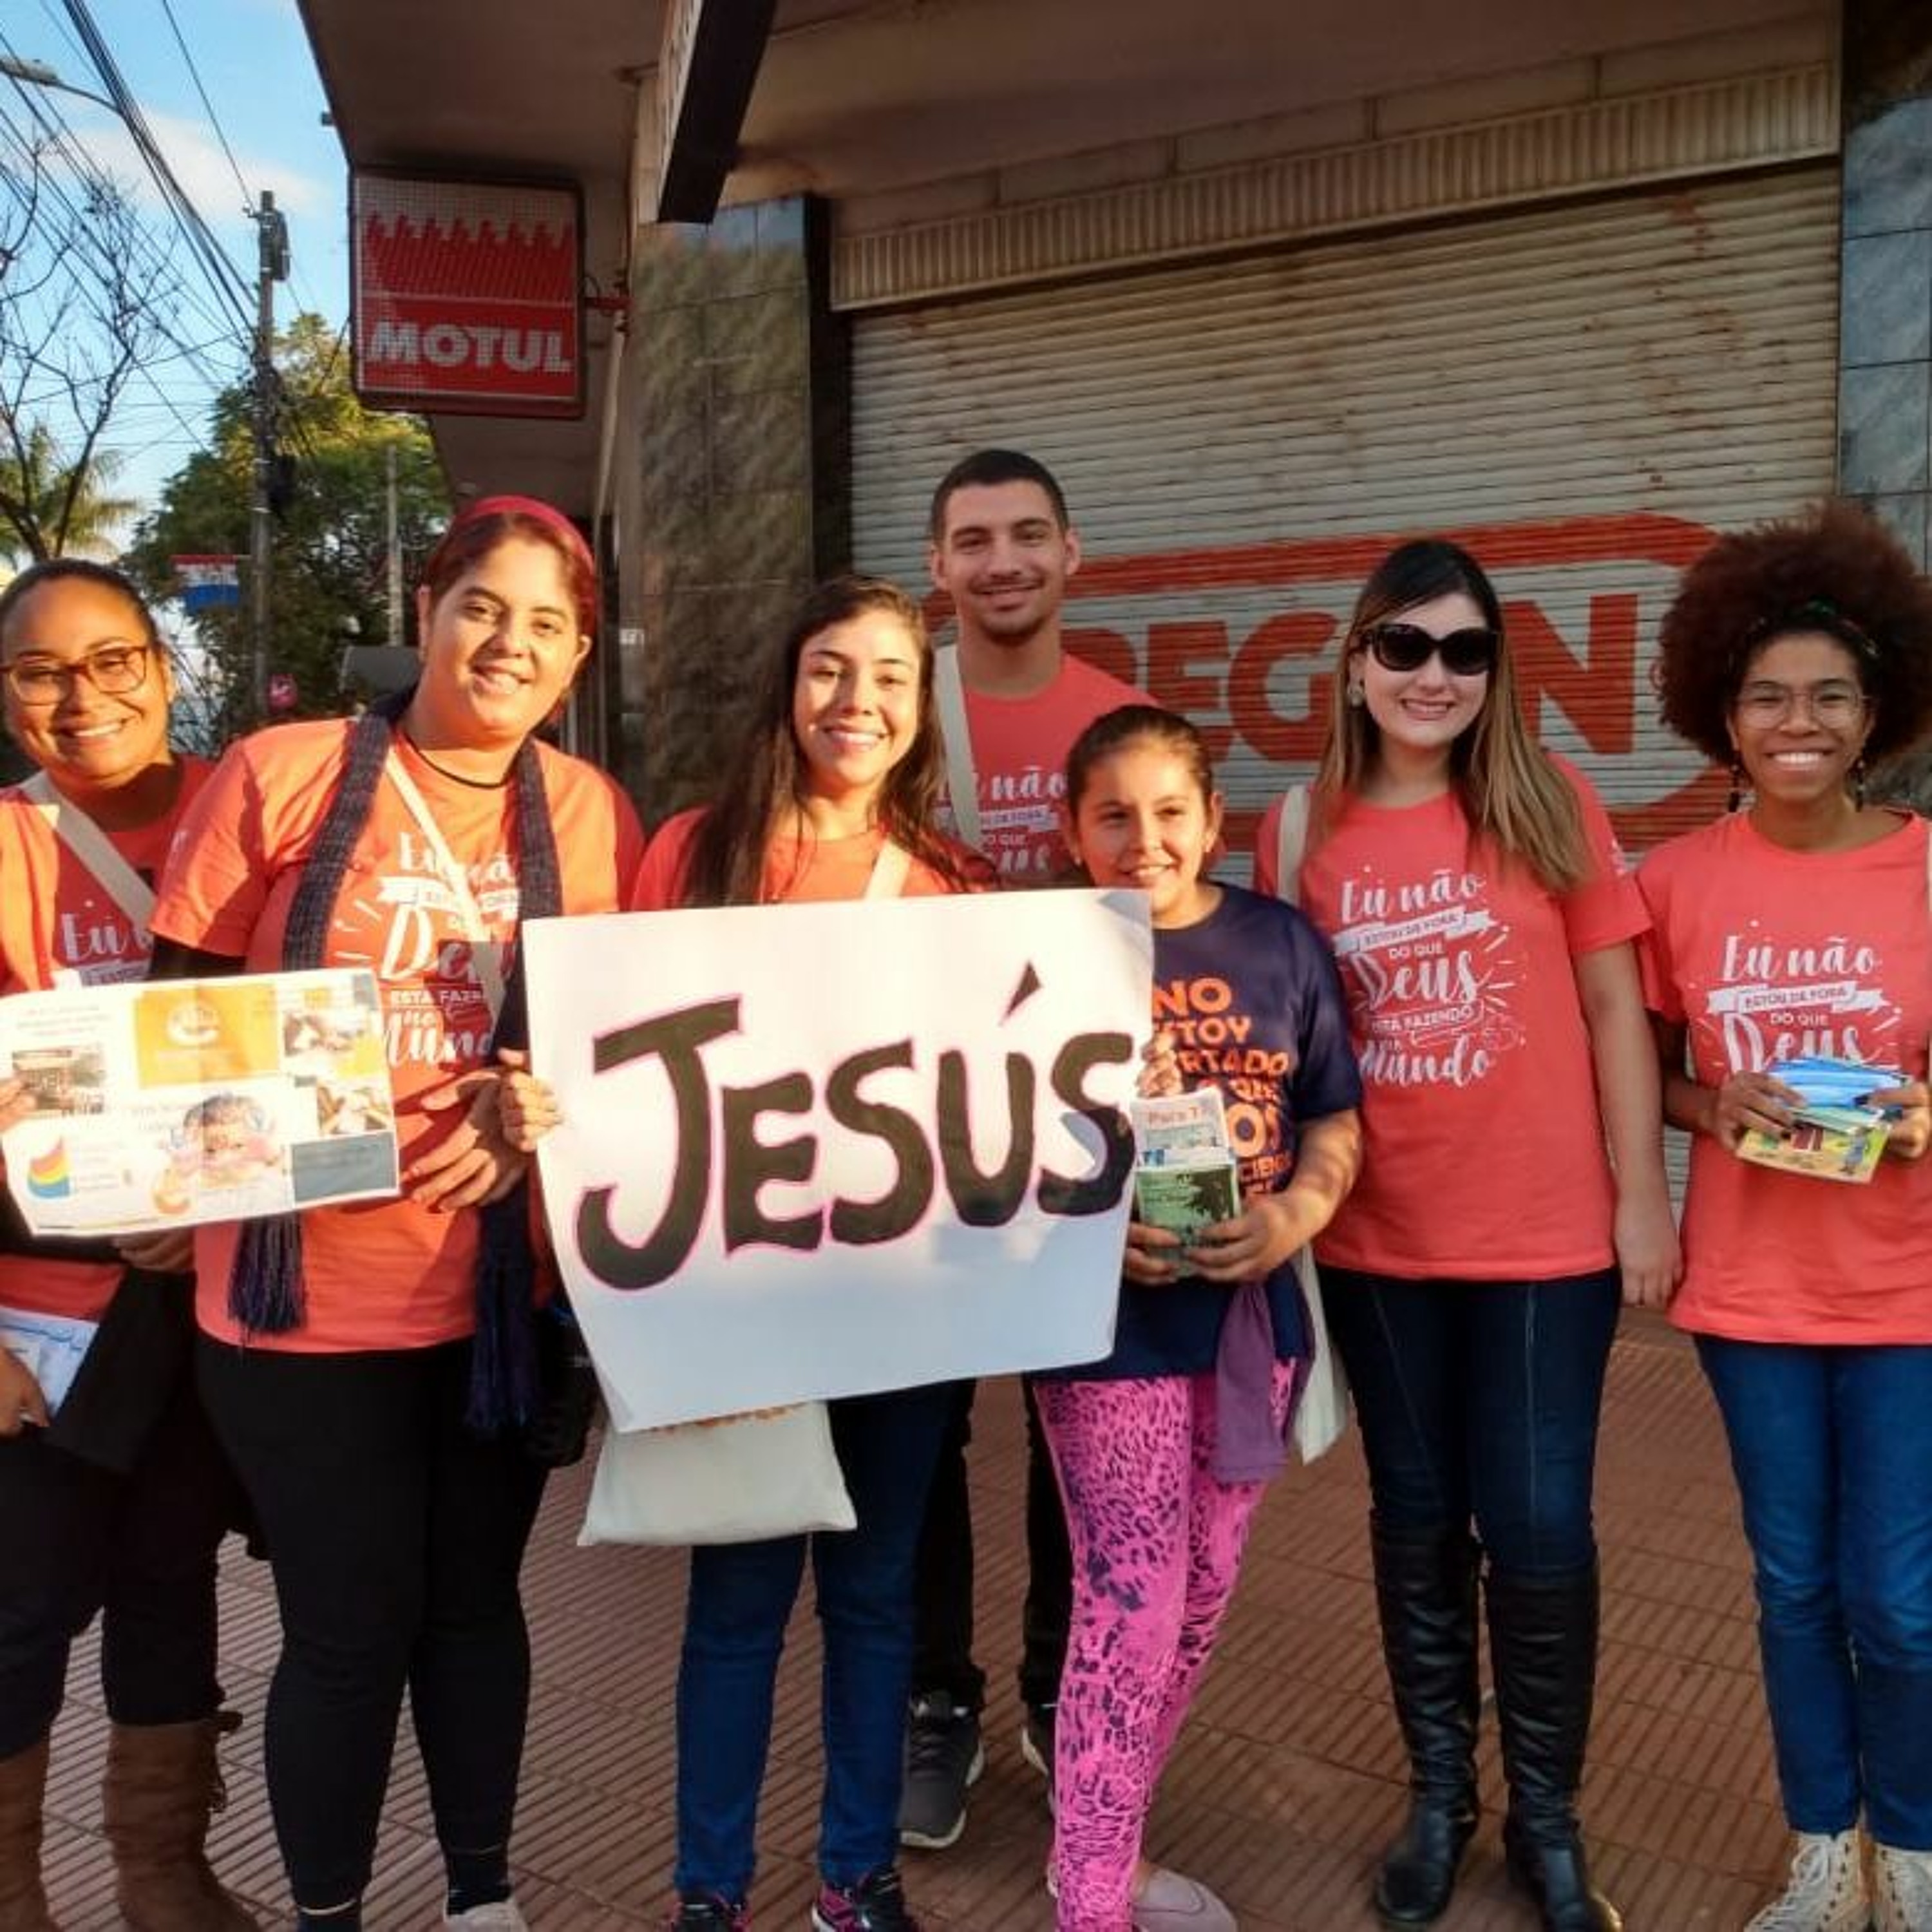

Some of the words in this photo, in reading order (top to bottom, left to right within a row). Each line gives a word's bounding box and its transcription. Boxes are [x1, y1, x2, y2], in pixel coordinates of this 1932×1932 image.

[368, 319, 572, 372] MOTUL
[1399, 869, 1485, 912] não
[1388, 946, 1410, 960] DO
[1414, 940, 1444, 957] QUE
[1787, 936, 1882, 976] não
[1153, 978, 1231, 1019] NO
[1351, 951, 1481, 1011] Deus
[1770, 1012, 1794, 1025] DO
[1798, 1012, 1830, 1025] QUE
[575, 960, 1137, 1290] JESÚS
